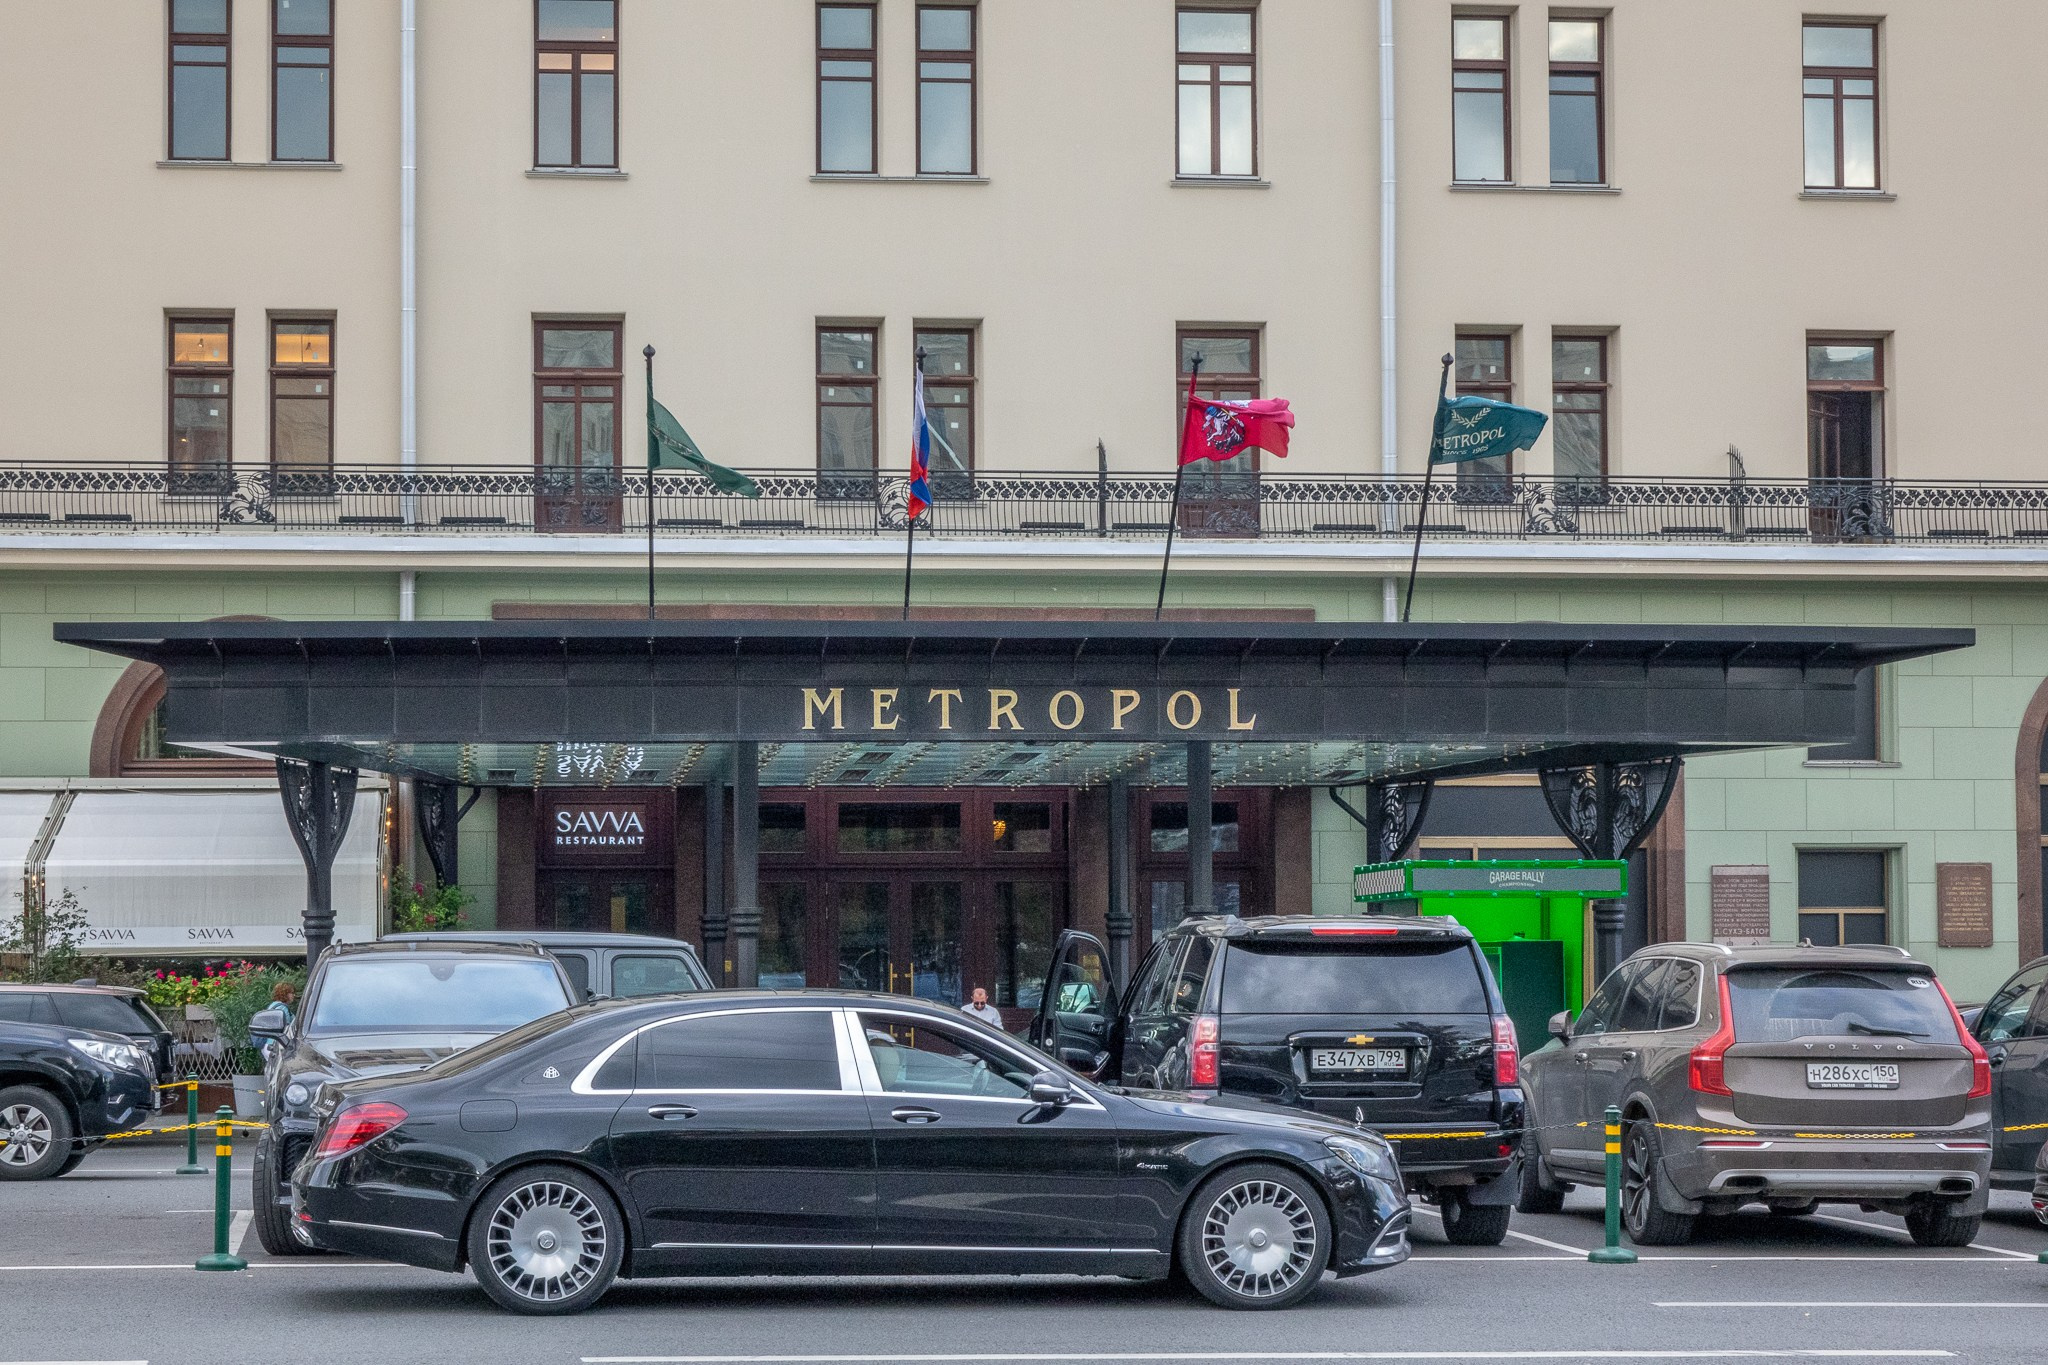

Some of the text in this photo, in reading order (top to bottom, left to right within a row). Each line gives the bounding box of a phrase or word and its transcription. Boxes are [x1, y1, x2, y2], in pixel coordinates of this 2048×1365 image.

[801, 687, 1257, 731] METROPOL
[556, 811, 645, 833] SAVVA
[556, 836, 645, 845] RESTAURANT
[1489, 871, 1545, 884] GARAGE RALLY
[89, 929, 136, 940] SAVVA
[188, 928, 234, 939] SAVVA
[1722, 927, 1770, 935] СУХЭ-БАТОР
[1804, 1043, 1904, 1051] VOLVO
[1378, 1050, 1401, 1062] 799
[1873, 1065, 1895, 1077] 150
[1136, 1162, 1169, 1170] 4MATIC
